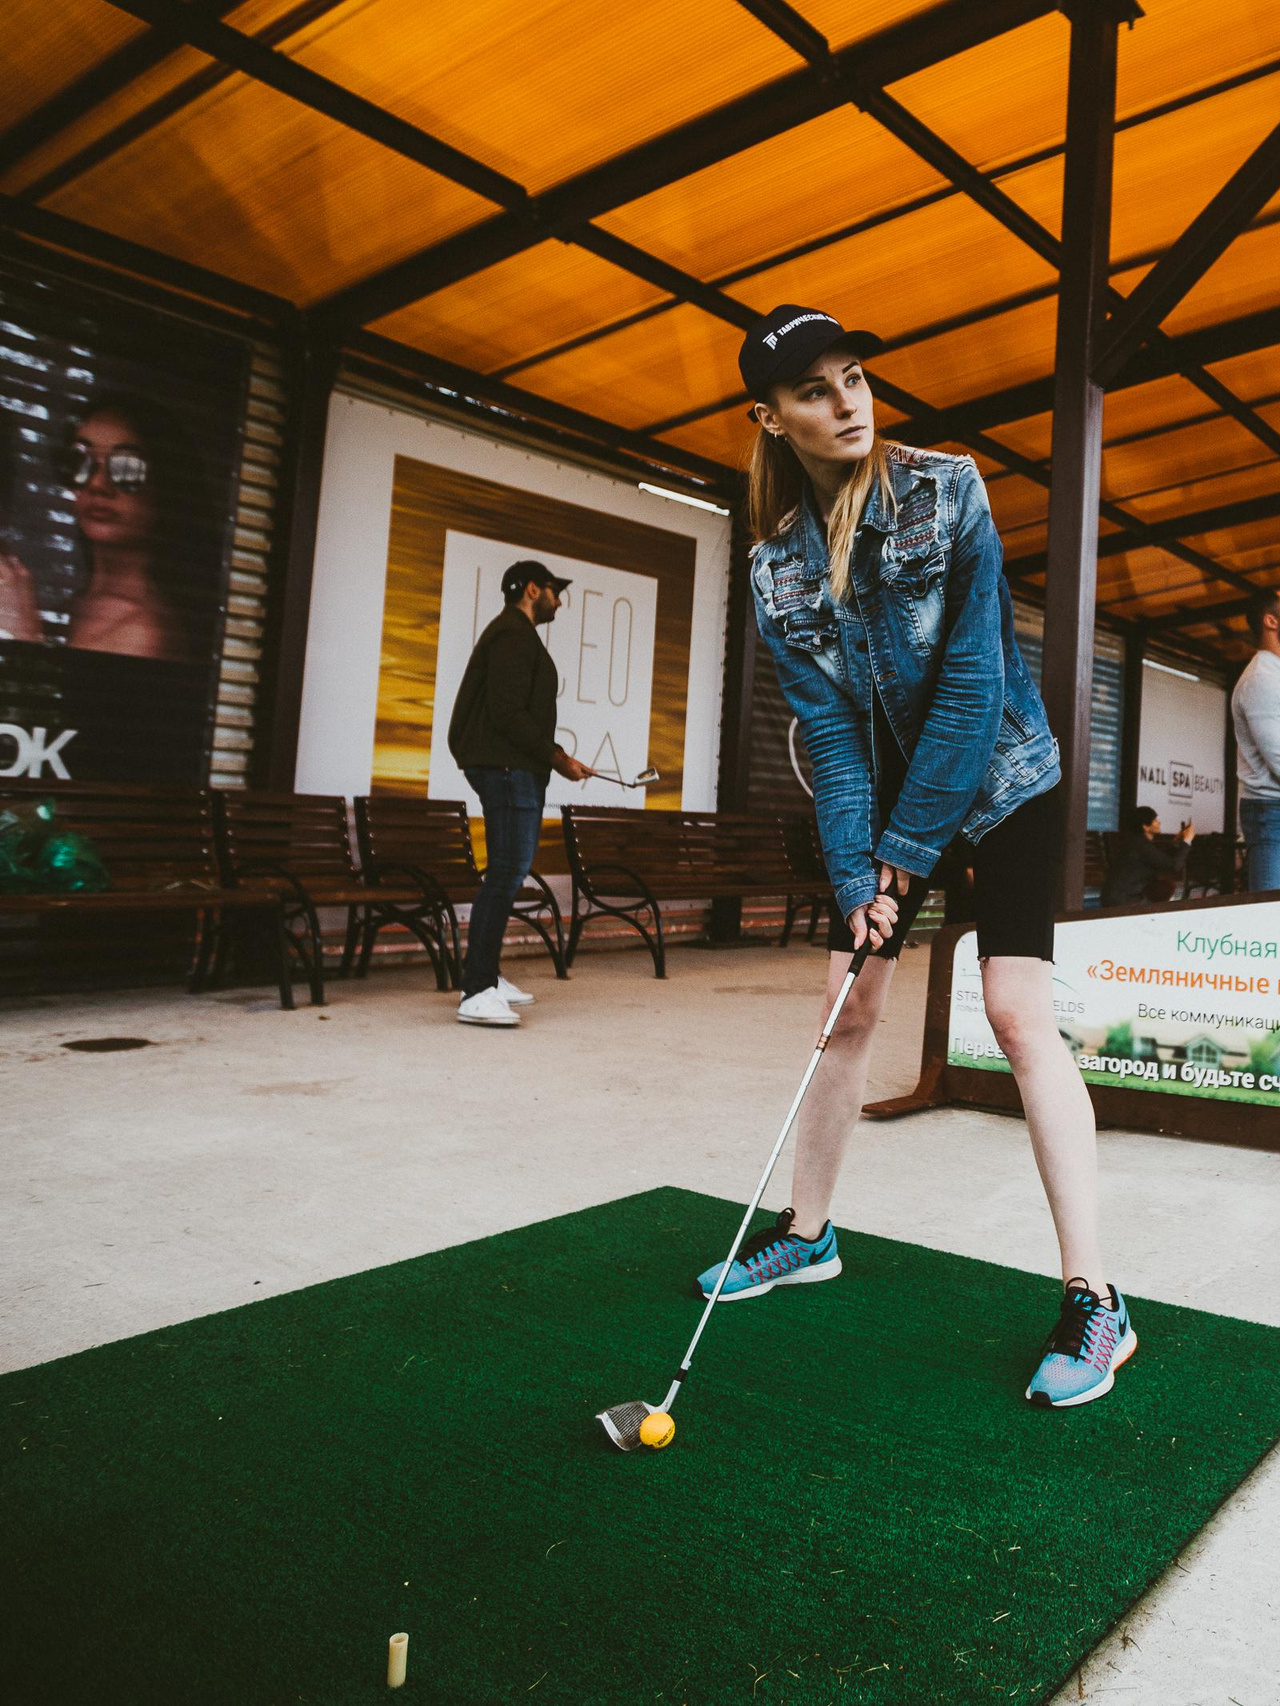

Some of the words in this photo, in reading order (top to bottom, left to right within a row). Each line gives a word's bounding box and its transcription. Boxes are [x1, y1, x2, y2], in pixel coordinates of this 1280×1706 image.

[1140, 765, 1166, 786] NAIL
[1172, 770, 1191, 789] SPA
[1176, 930, 1278, 960] Клубная
[1086, 959, 1270, 995] «Земляничные
[1138, 1002, 1166, 1019] Все
[1079, 1054, 1160, 1081] загород
[1162, 1063, 1177, 1080] и
[1180, 1061, 1255, 1089] будьте
